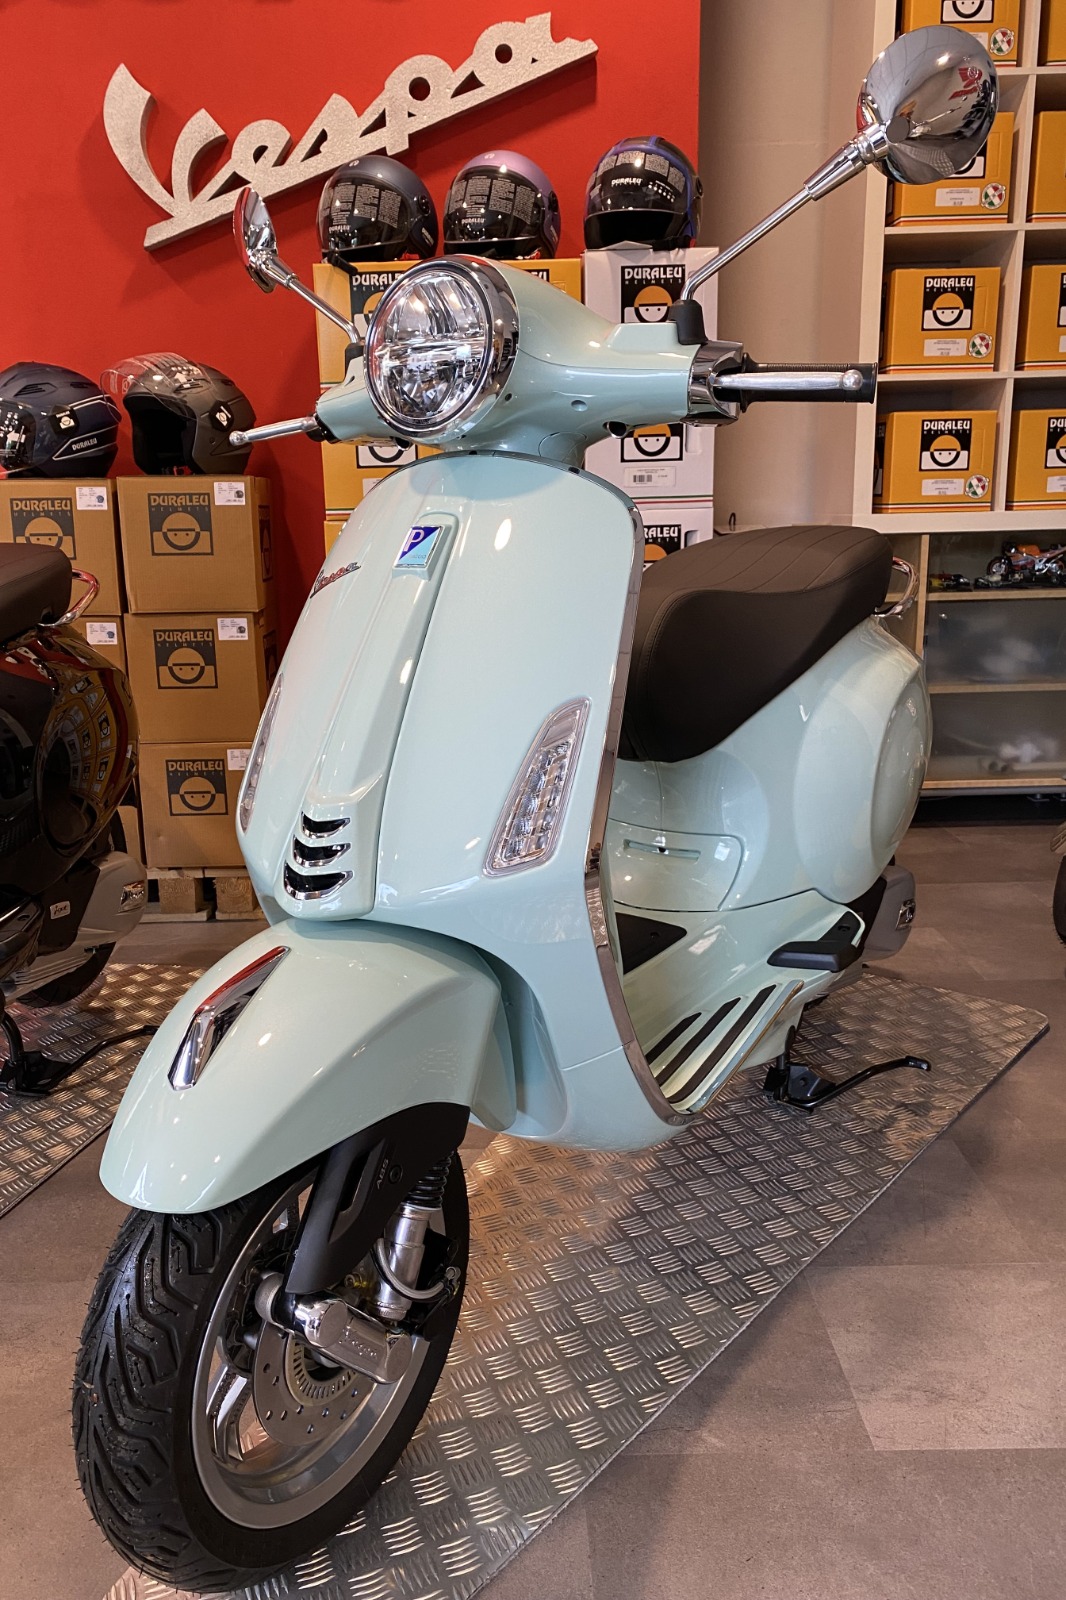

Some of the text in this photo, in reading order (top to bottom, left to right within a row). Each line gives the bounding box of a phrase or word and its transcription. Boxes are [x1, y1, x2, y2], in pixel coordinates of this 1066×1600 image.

[103, 12, 598, 250] Vespa
[624, 267, 682, 279] DURALEU
[926, 277, 974, 288] DURALEU
[923, 420, 971, 431] DURALEU
[13, 500, 71, 511] DURALEU
[150, 495, 209, 506] DURALEU
[156, 631, 213, 642] DURALEU
[168, 761, 223, 771] DURALEU
